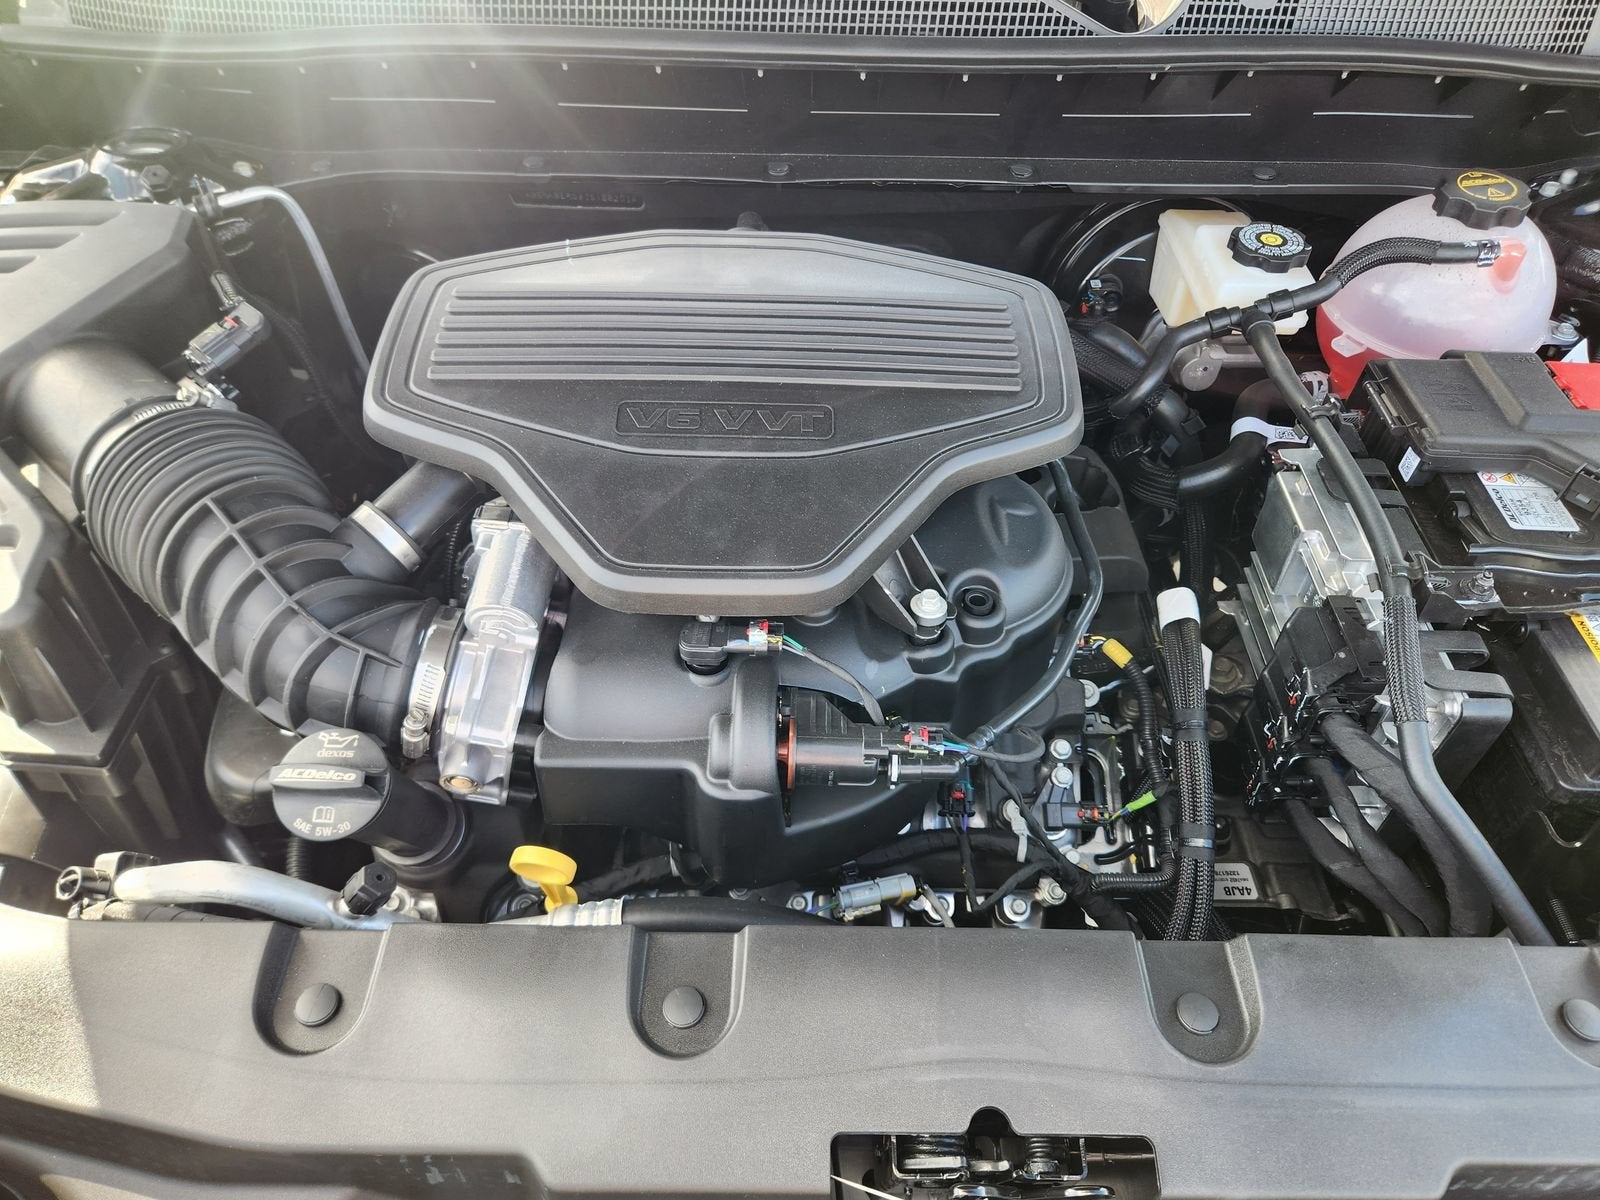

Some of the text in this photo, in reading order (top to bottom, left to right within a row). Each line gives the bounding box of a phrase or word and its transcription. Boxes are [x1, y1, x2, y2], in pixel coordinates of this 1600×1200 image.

[626, 407, 825, 432] V6 VVT
[1492, 488, 1520, 524] ACDelco
[317, 749, 355, 758] dexos
[277, 768, 357, 781] ACDelco
[293, 818, 352, 837] SAE 5W-30
[1223, 886, 1252, 896] 4AJB
